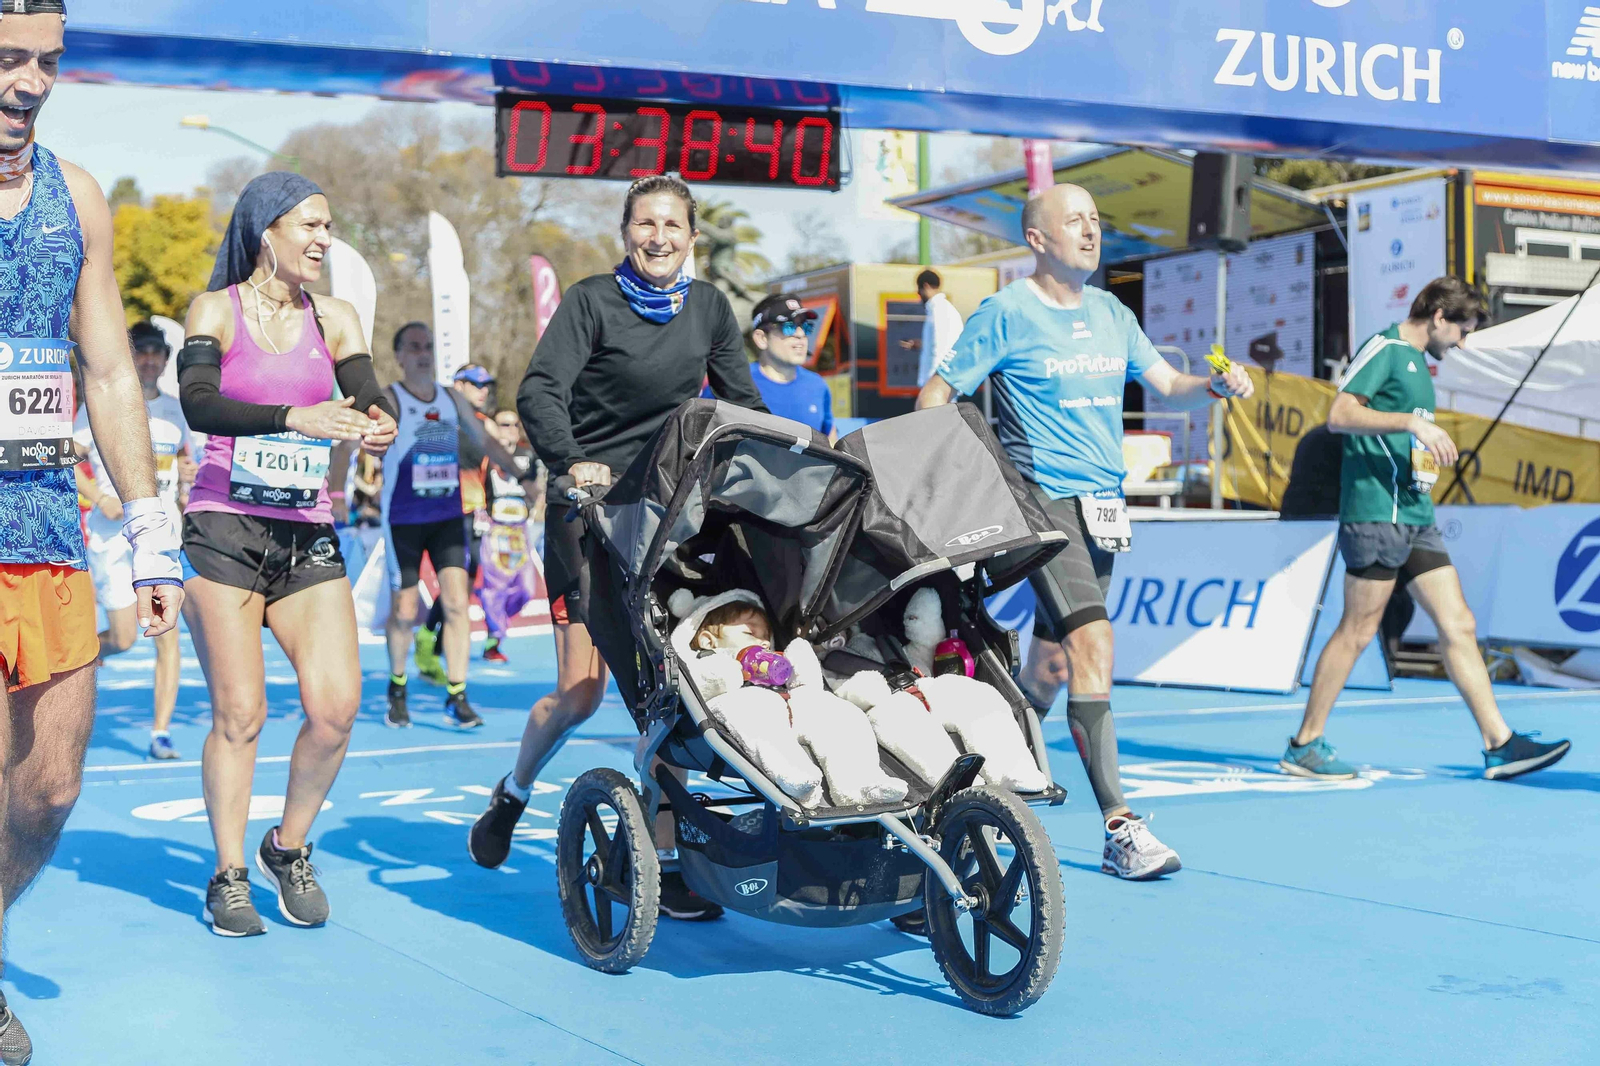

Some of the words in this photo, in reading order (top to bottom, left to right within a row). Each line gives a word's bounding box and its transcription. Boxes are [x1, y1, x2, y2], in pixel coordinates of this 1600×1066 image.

[1214, 27, 1443, 104] ZURICH
[1551, 60, 1587, 80] new
[505, 100, 833, 186] 03:38:40
[19, 348, 64, 364] ZURICH
[9, 387, 62, 415] 6222
[1255, 399, 1304, 437] IMD
[255, 450, 310, 473] 12011
[1513, 459, 1575, 502] IMD
[1096, 507, 1117, 523] 7920
[1110, 577, 1266, 629] URICH
